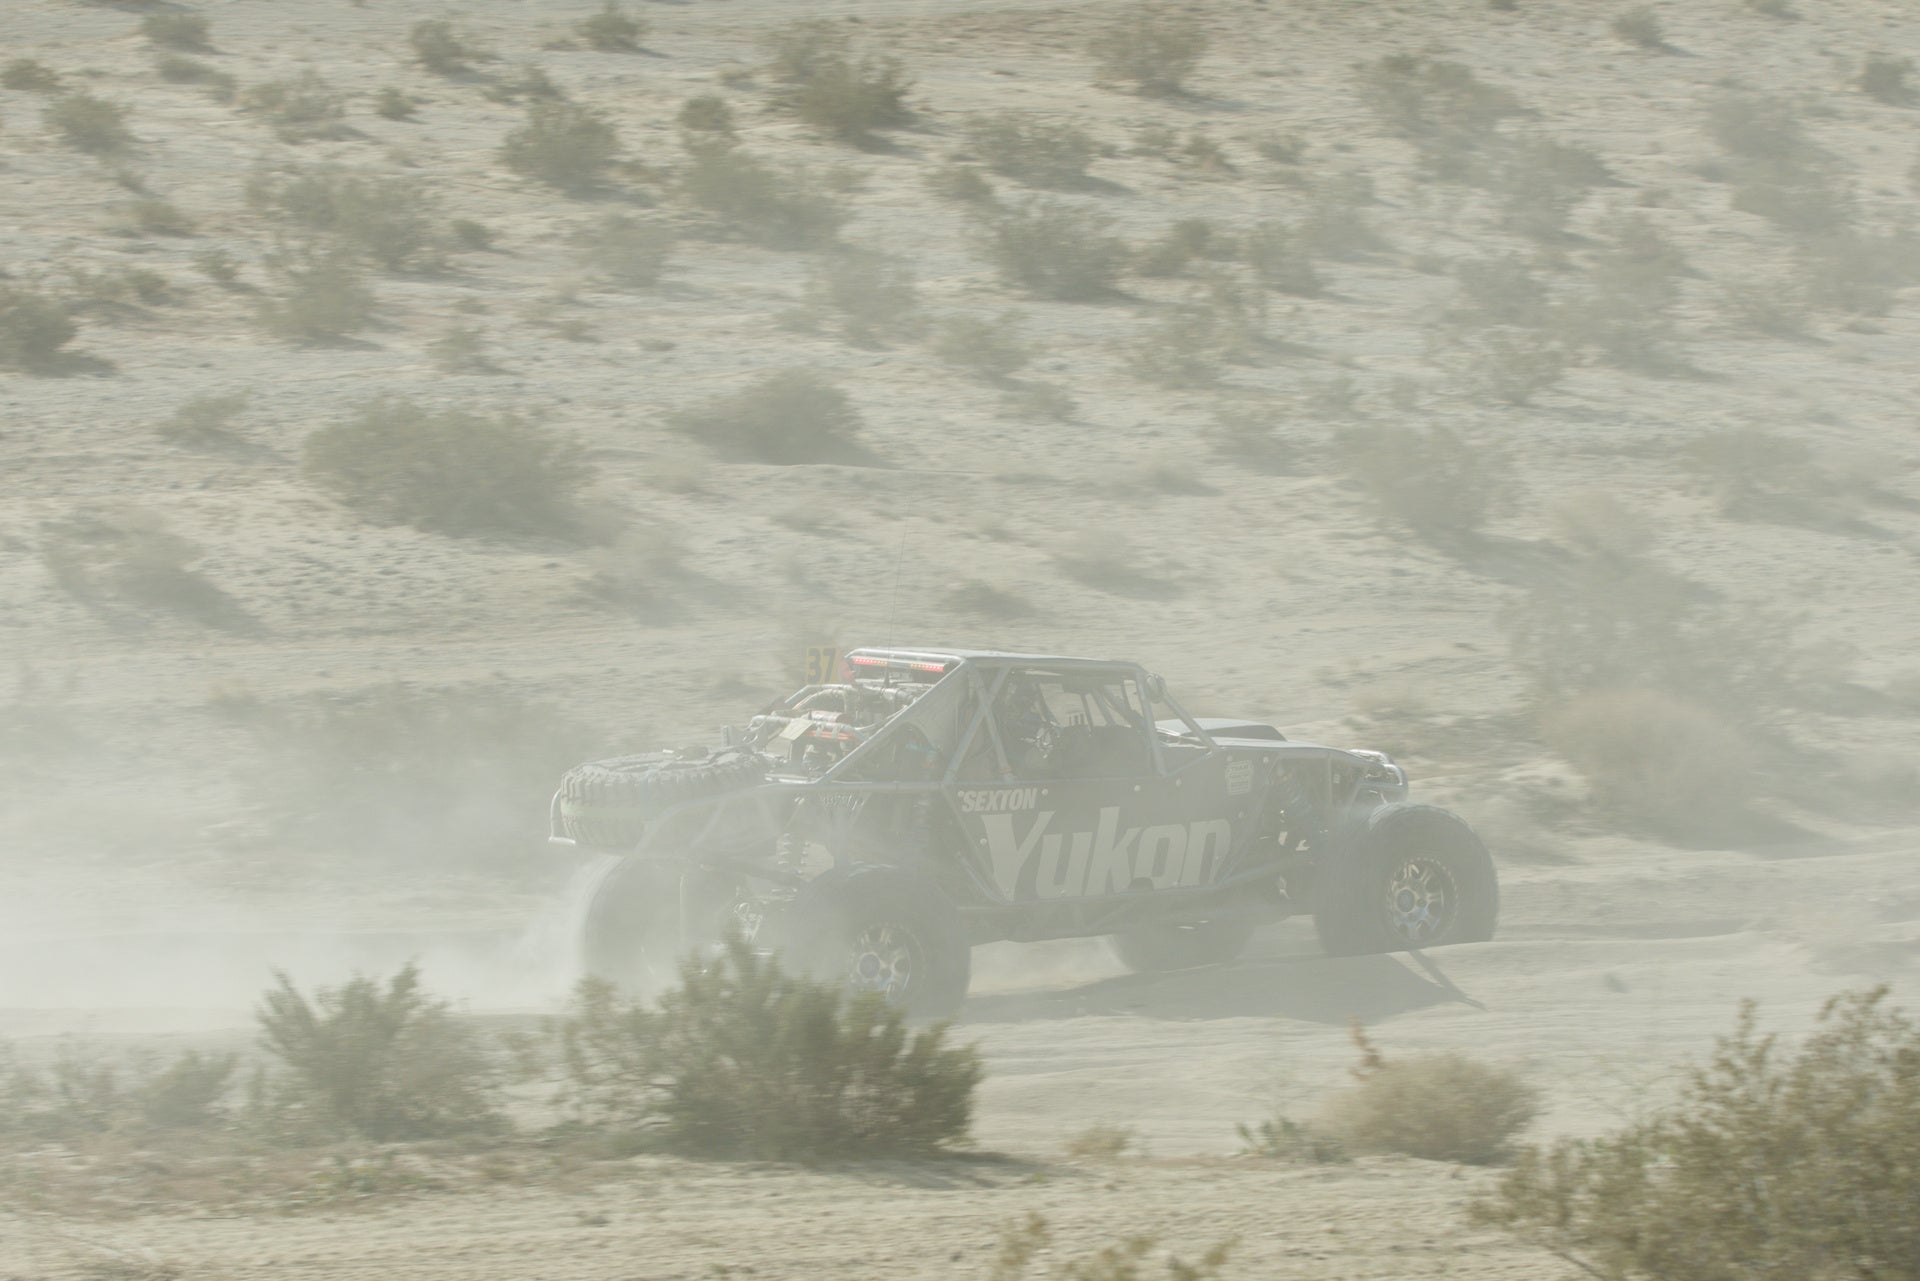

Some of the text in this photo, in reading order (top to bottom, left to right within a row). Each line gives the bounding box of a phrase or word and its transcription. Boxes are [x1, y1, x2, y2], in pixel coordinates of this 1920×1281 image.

[808, 648, 836, 683] 37
[961, 788, 1038, 812] SEXTON
[981, 806, 1231, 901] Yukon
